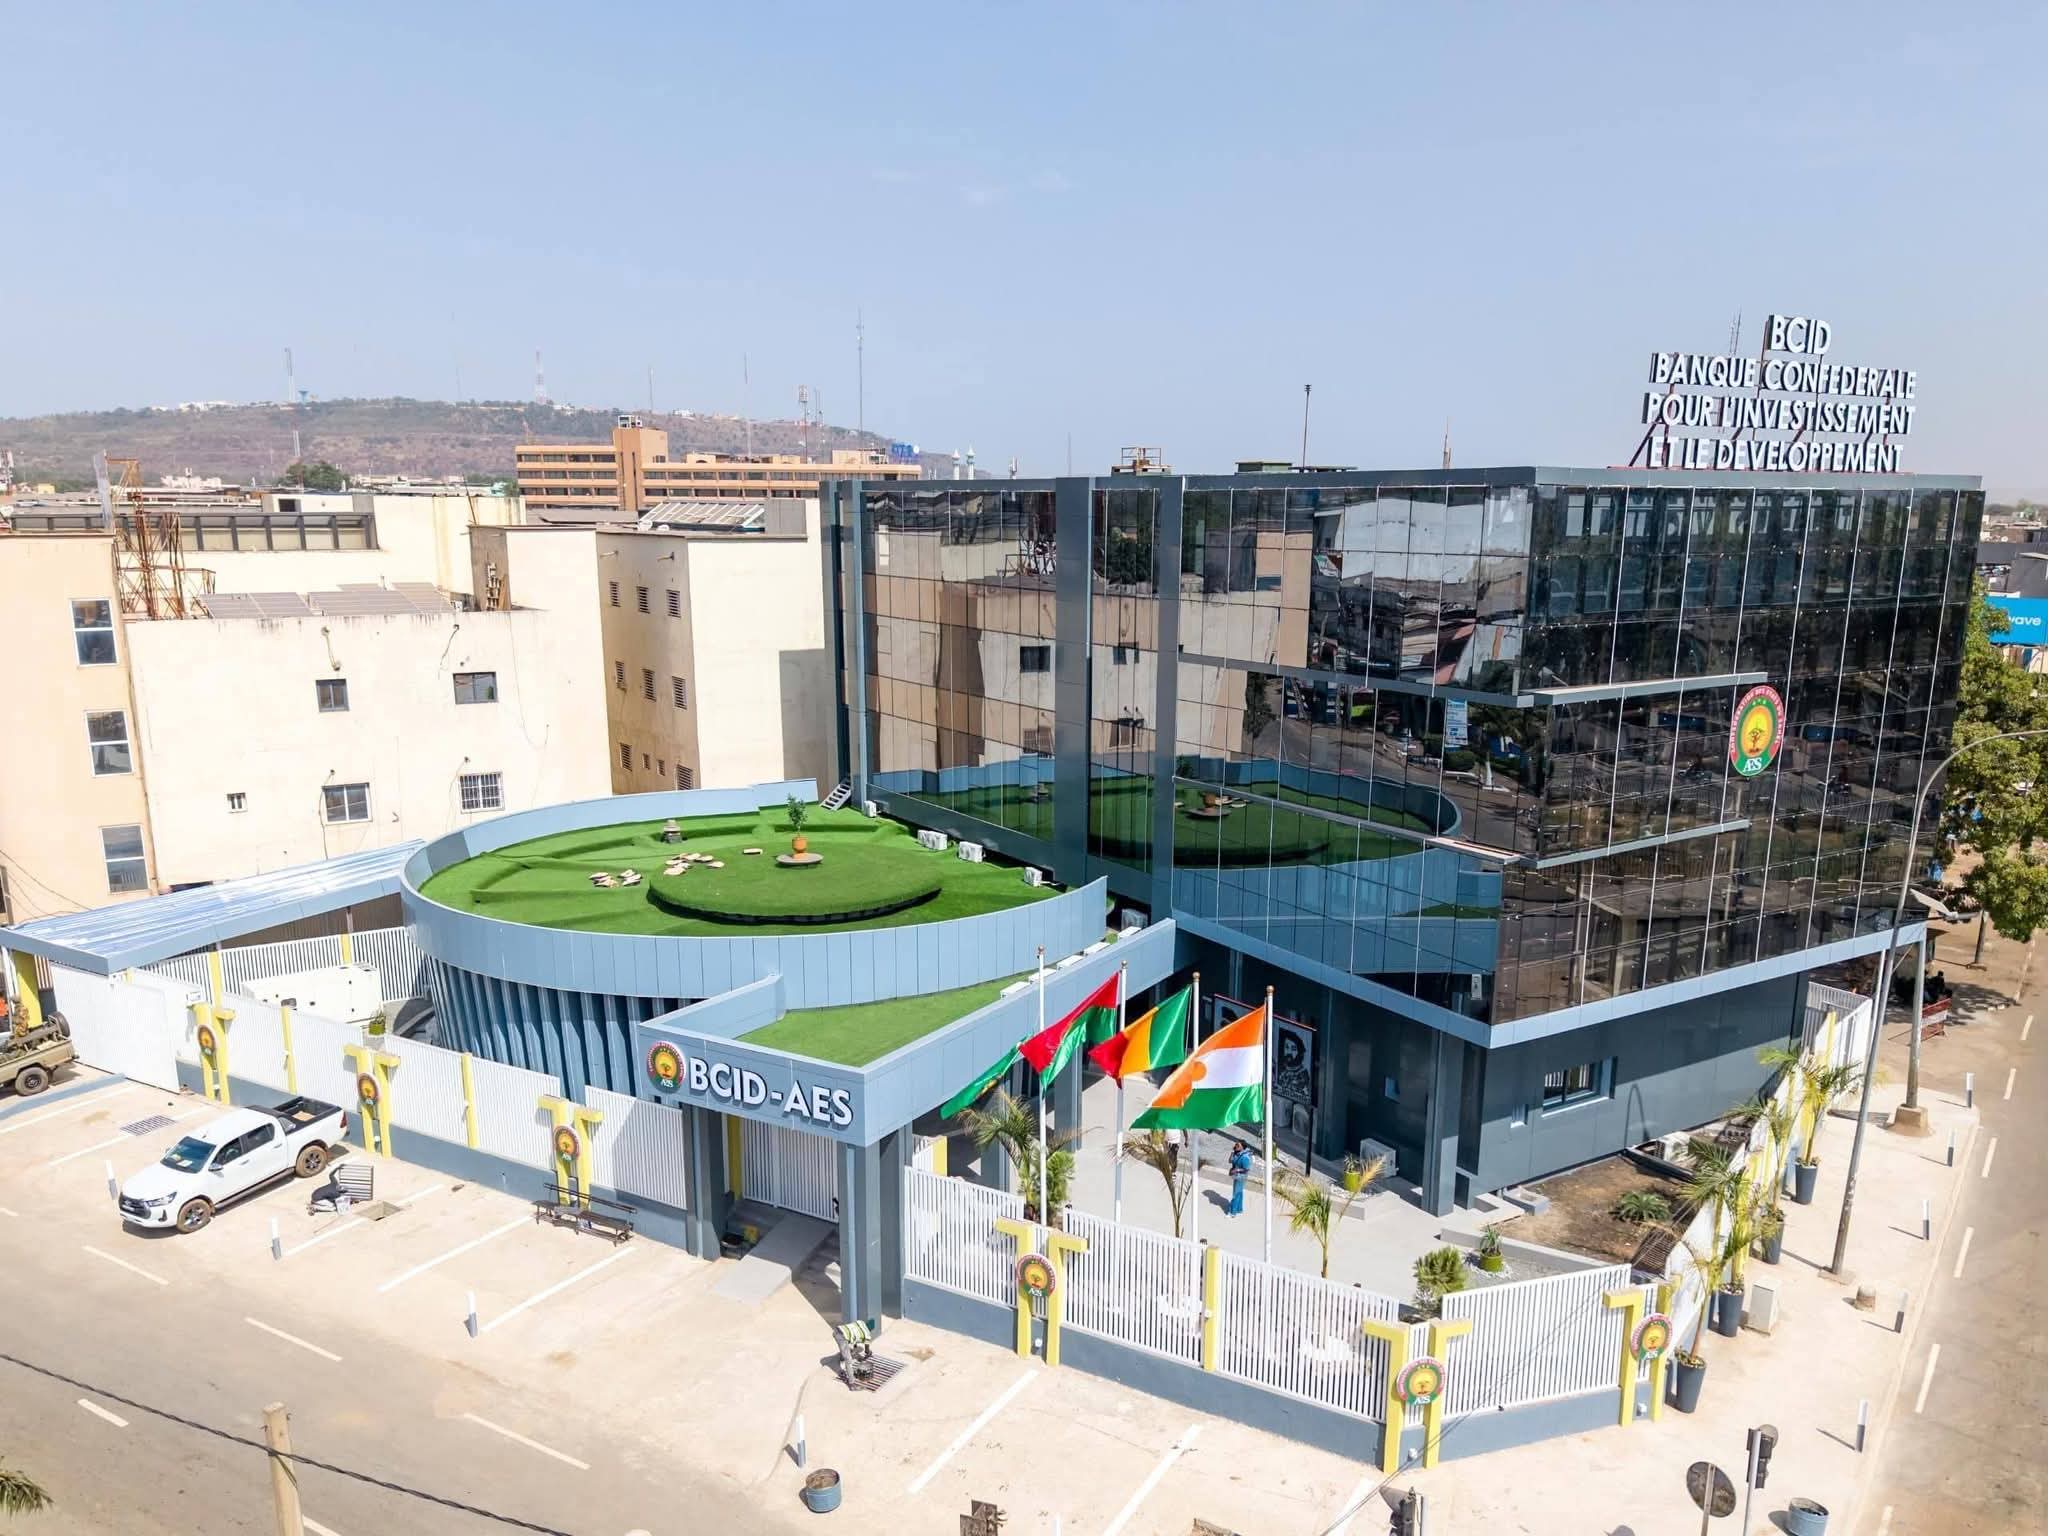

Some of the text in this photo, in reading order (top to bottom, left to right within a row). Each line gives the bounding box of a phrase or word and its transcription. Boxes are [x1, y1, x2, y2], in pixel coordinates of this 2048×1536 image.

[1769, 314, 1832, 355] BCID
[1655, 353, 1917, 399] BANQUE CONFEDERALE
[1646, 392, 1916, 435] POUR L'INVESTISSEMENT
[1649, 436, 1904, 473] ET LE DEVELOPPEMENT
[689, 1056, 854, 1127] BCID-AES
